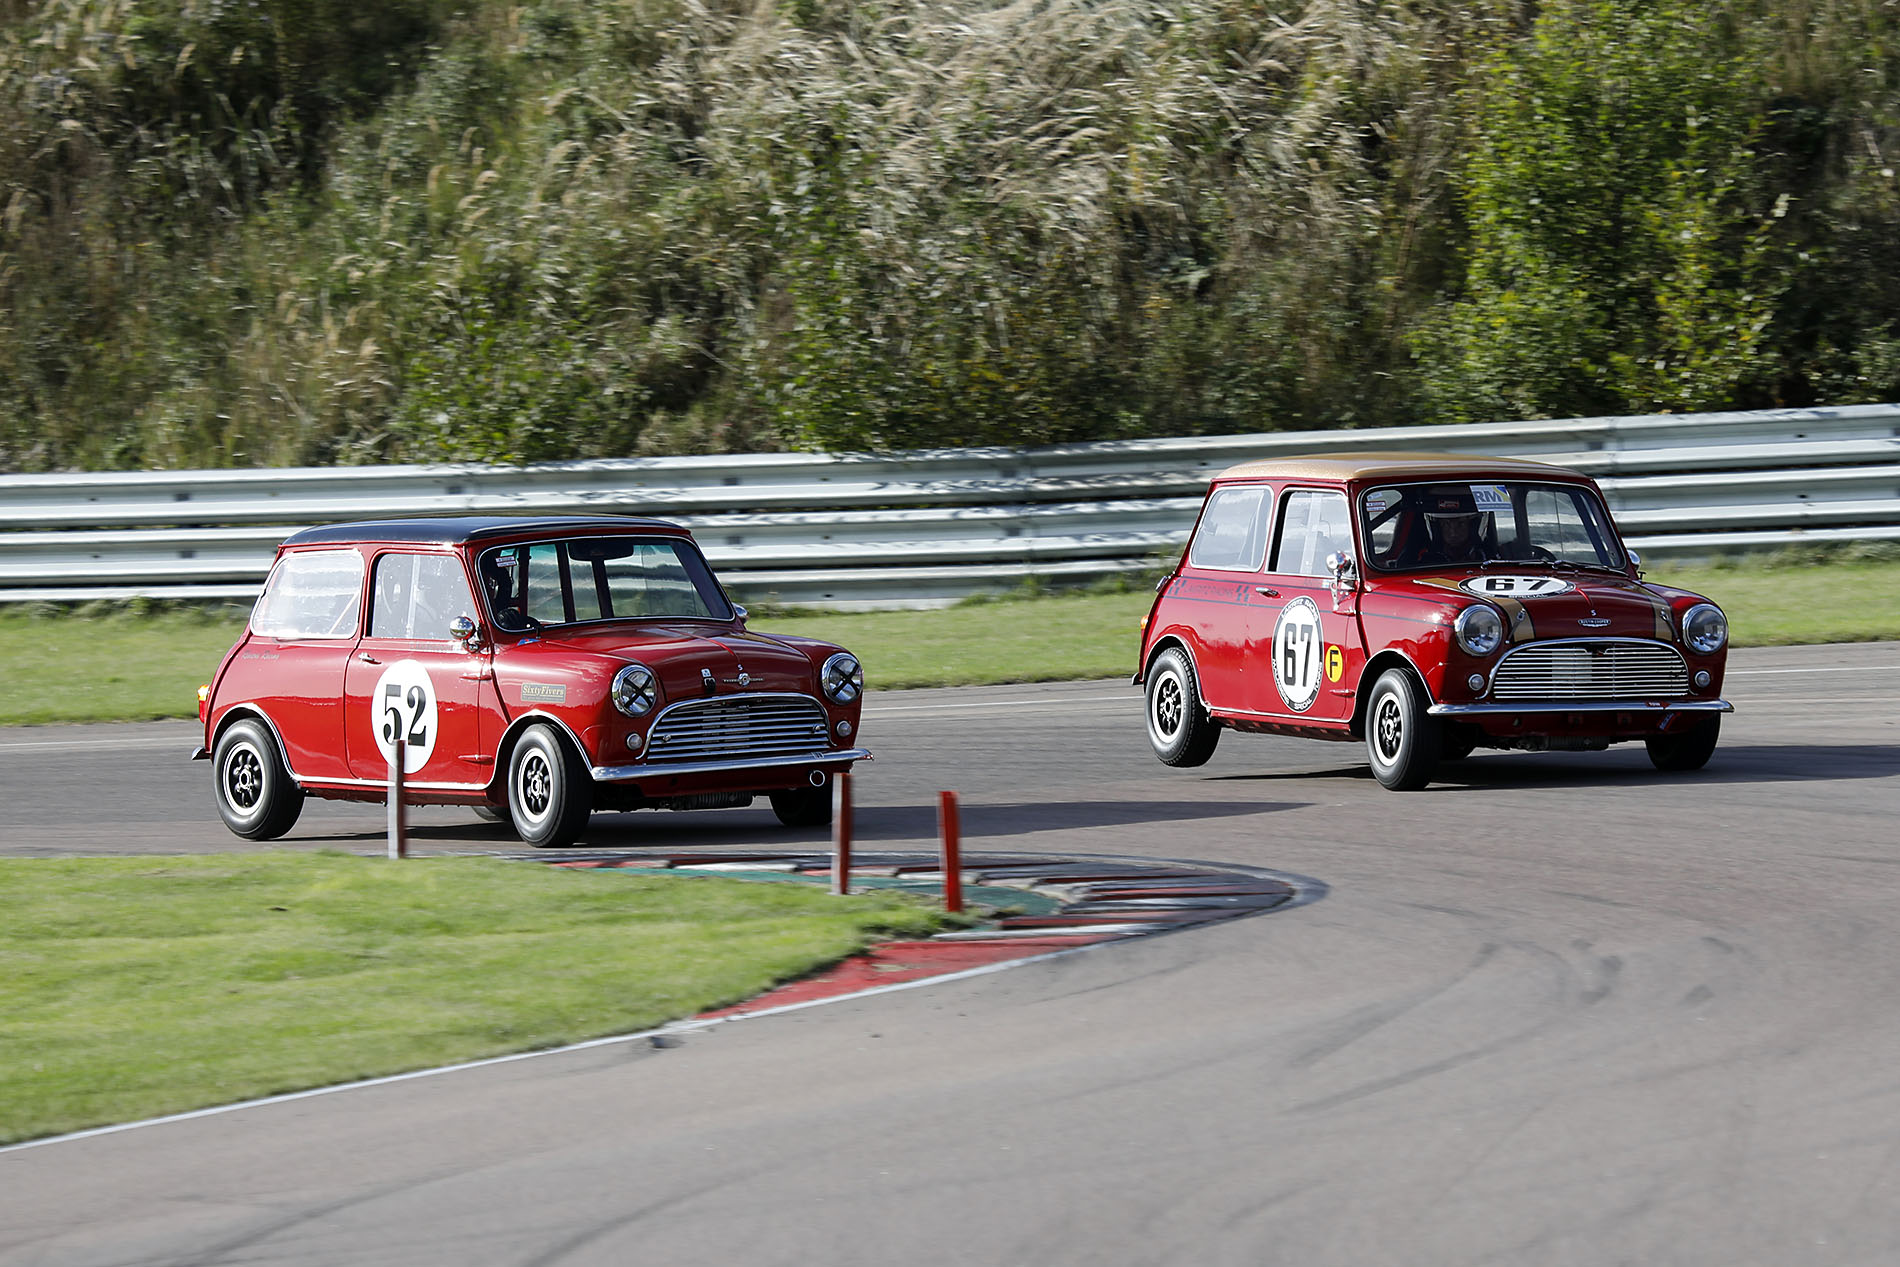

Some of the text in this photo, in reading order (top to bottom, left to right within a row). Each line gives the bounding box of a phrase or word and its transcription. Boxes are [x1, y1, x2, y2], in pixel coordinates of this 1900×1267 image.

[1486, 578, 1551, 591] 67
[1284, 623, 1313, 687] 67
[1330, 649, 1339, 679] F
[523, 684, 564, 696] SixtyFivers
[383, 684, 426, 746] 52
